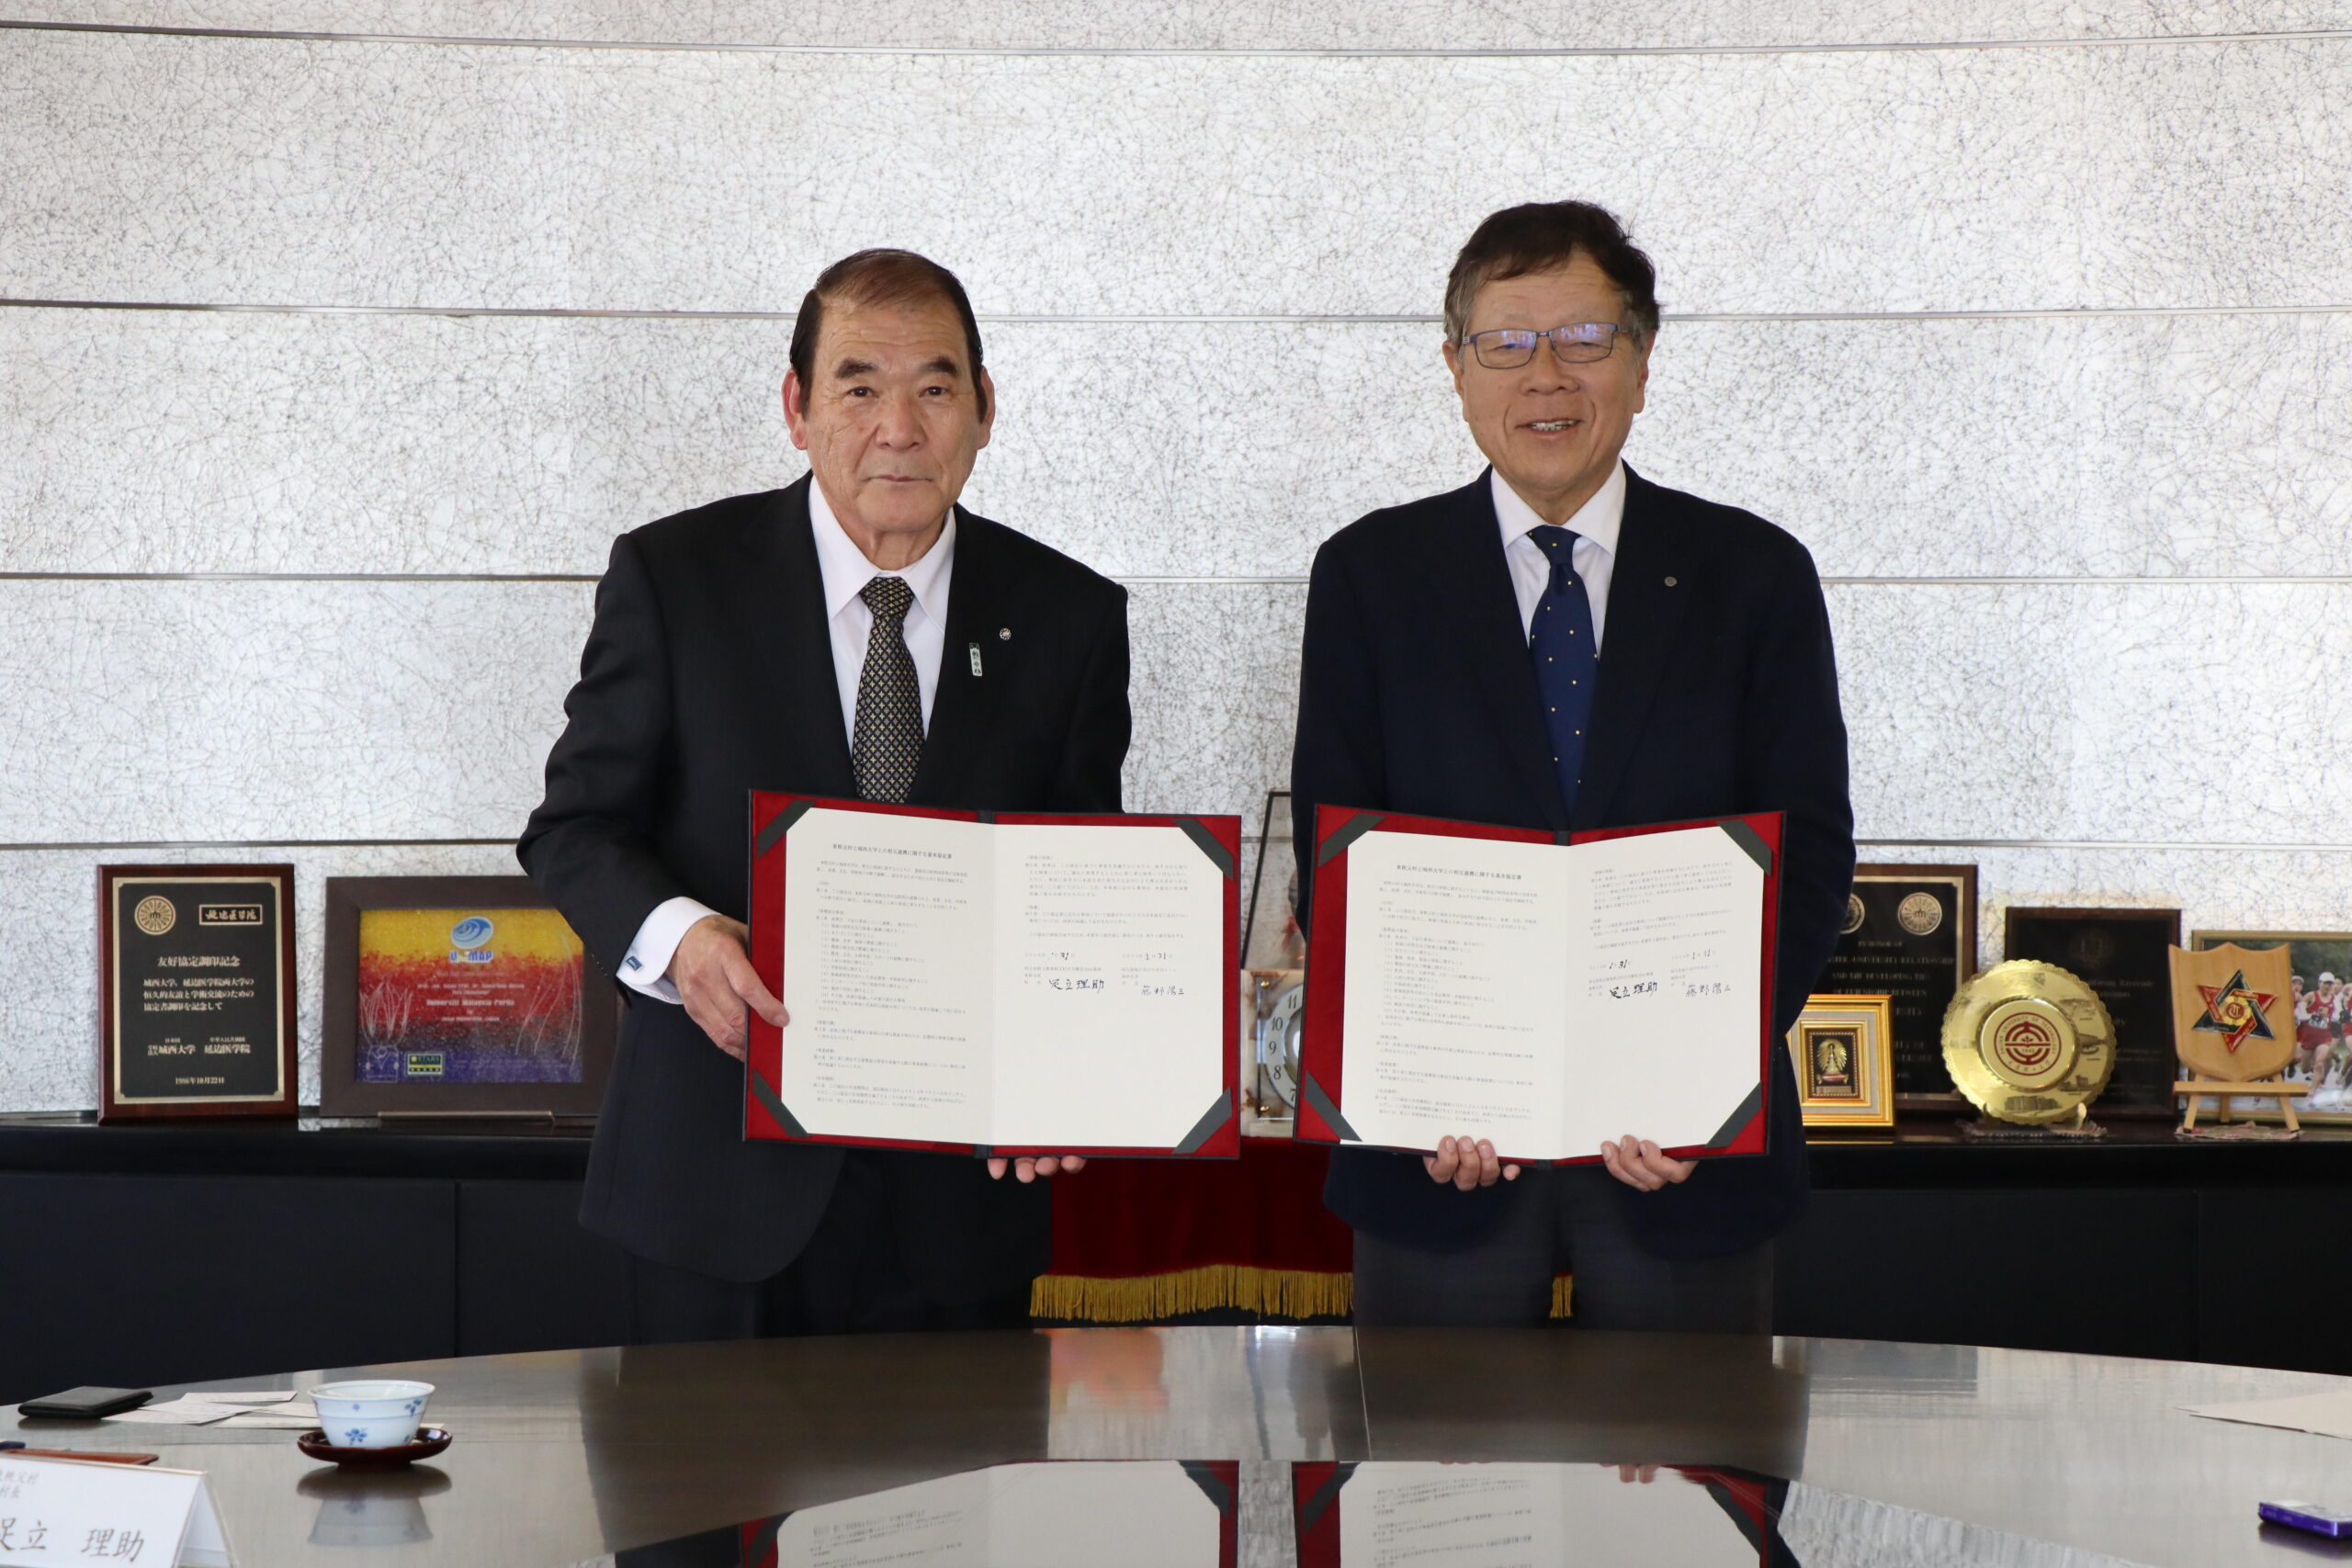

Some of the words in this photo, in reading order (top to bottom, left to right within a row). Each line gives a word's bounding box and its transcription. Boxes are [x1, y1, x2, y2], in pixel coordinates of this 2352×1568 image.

[1287, 994, 1297, 1009] 11
[1272, 1017, 1283, 1031] 10
[1269, 1041, 1277, 1055] 9
[1273, 1066, 1282, 1080] 8
[0, 1470, 40, 1485] 秩父村
[0, 1517, 48, 1551] 足立
[81, 1528, 144, 1562] 理助
